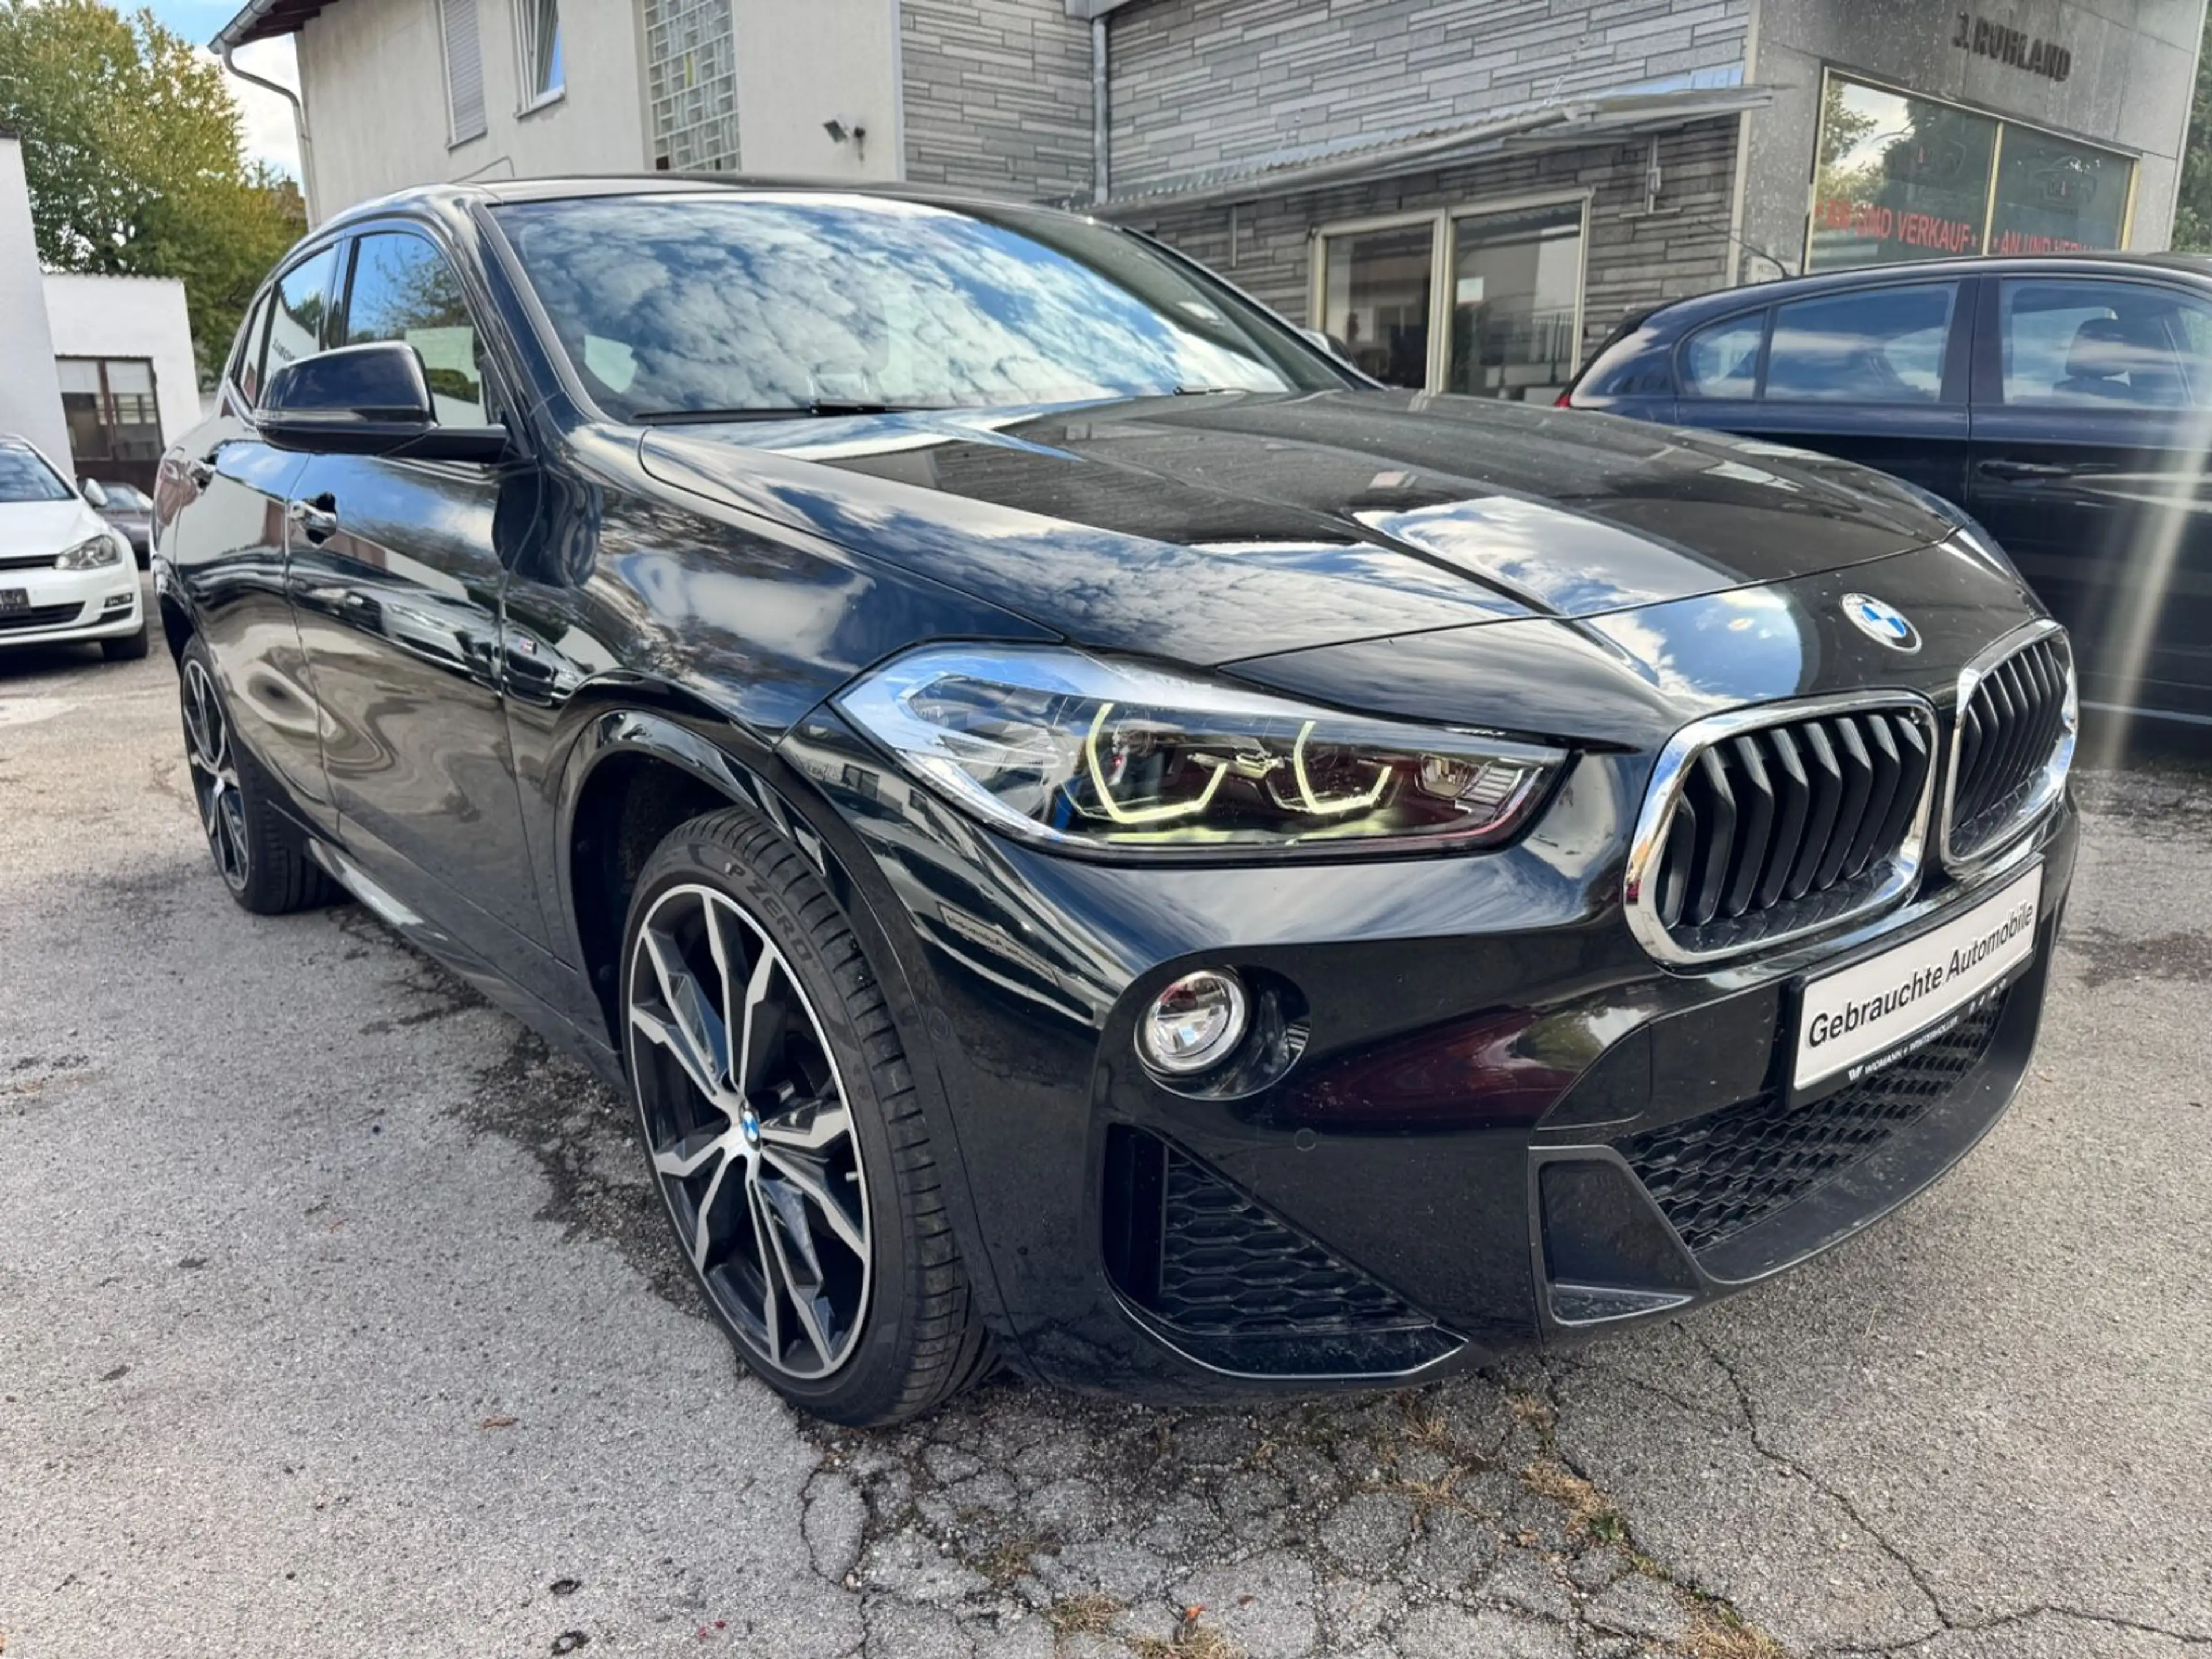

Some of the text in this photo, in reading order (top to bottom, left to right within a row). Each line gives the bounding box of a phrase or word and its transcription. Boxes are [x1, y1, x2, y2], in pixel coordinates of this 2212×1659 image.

[1898, 210, 1970, 253] VERKAUF
[1809, 965, 1943, 1048] Gebrauchte
[1946, 902, 2033, 983] Automobile
